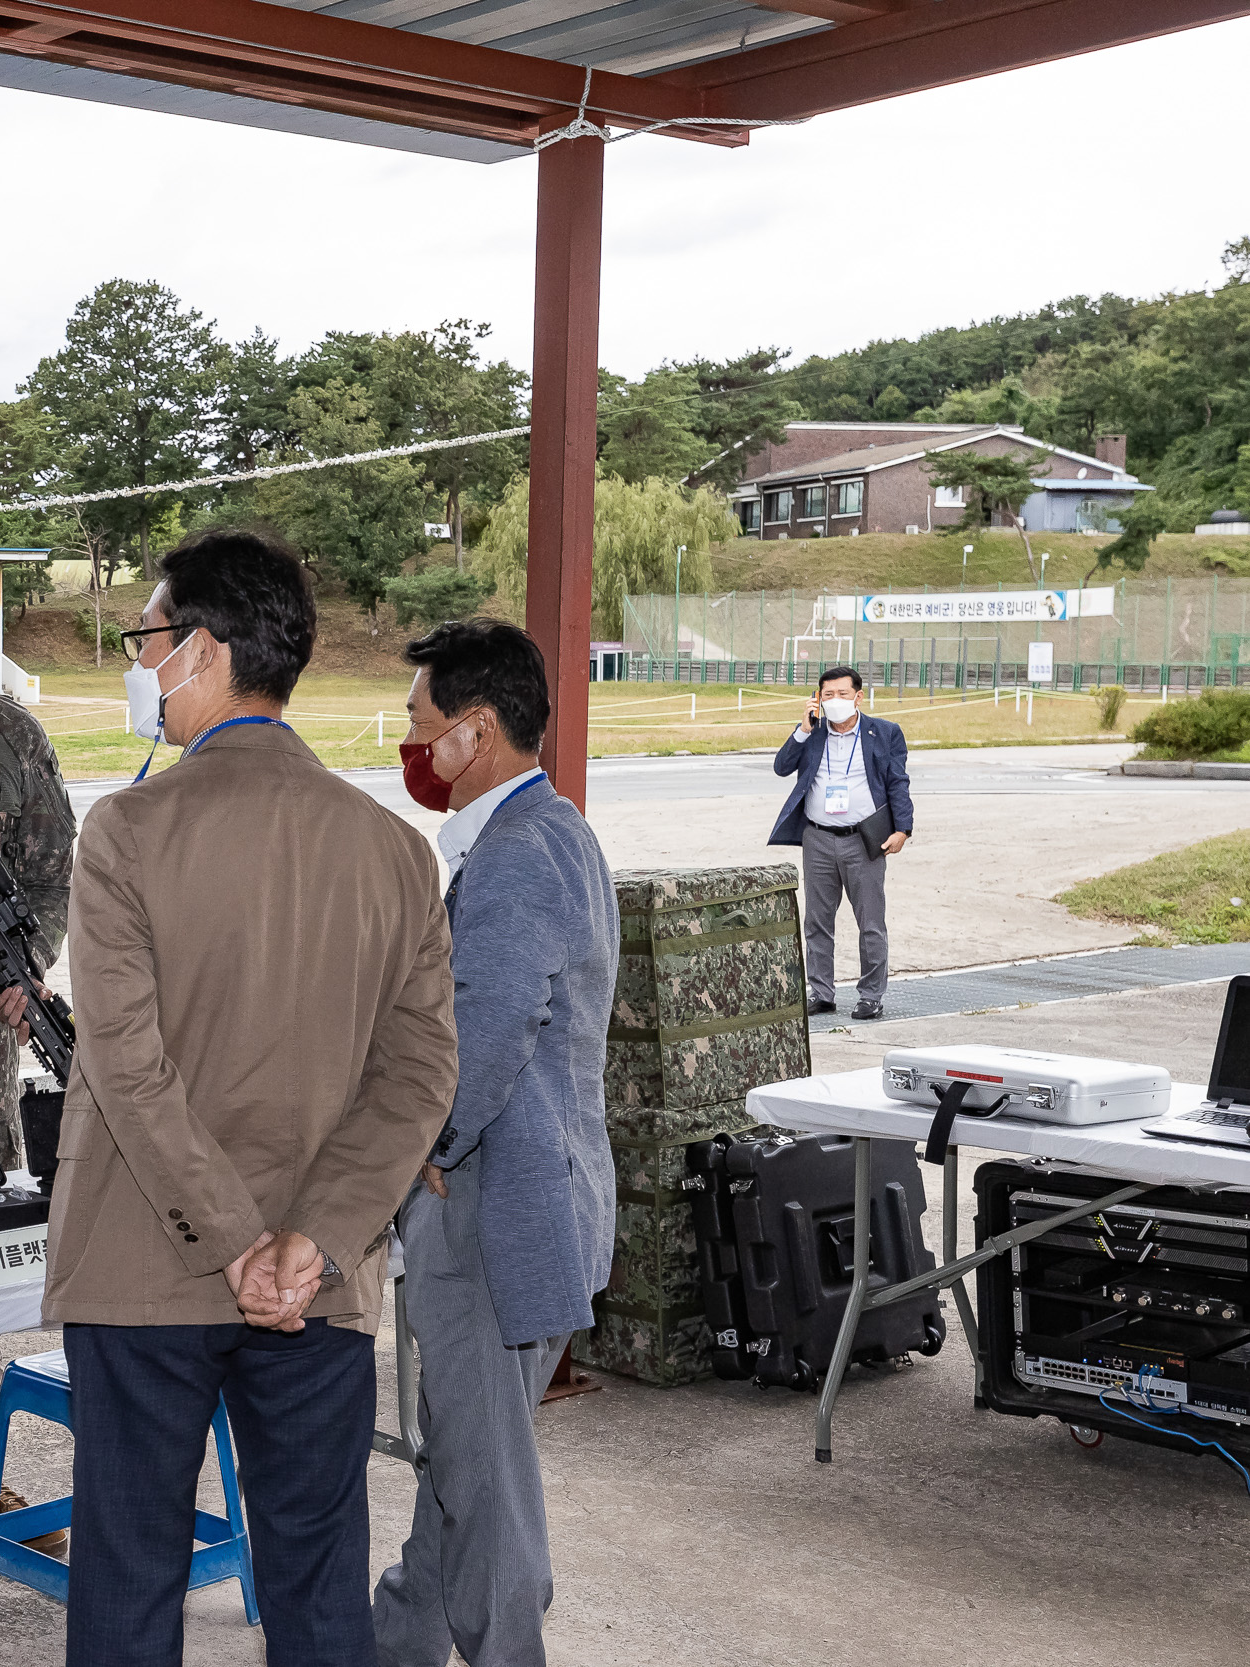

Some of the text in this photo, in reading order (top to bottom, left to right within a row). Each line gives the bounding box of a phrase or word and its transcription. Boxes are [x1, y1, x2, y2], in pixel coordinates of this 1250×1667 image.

[889, 601, 922, 617] 대한민국
[924, 601, 954, 617] 예비군!
[958, 601, 984, 616] 당신은
